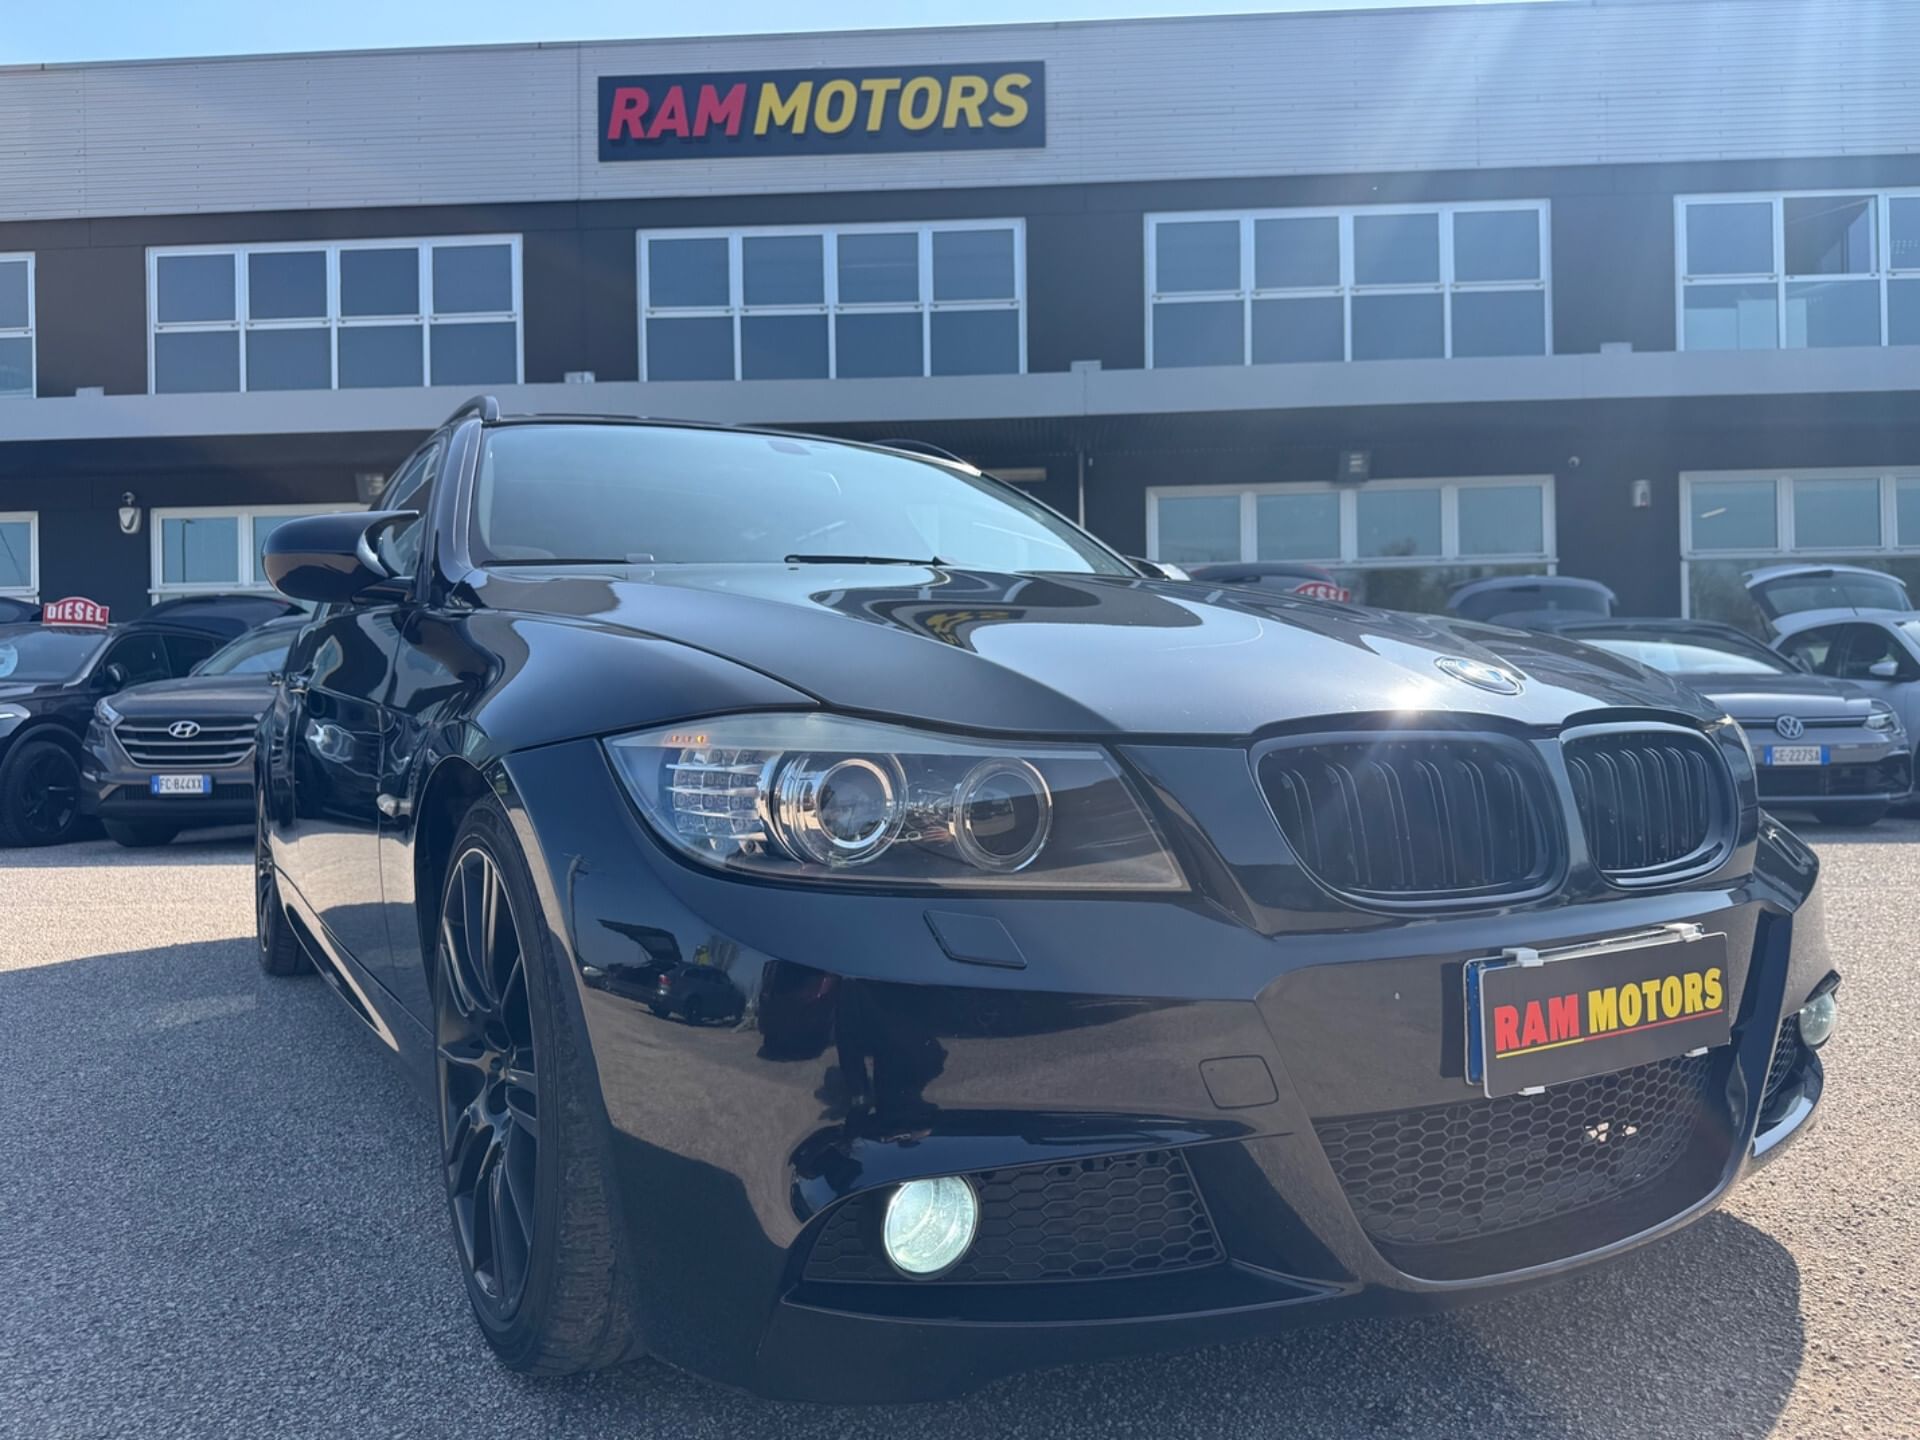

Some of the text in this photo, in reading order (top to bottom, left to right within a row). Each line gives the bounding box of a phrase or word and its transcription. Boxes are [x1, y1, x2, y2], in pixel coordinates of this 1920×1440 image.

[607, 73, 1032, 140] RAM MOTORS
[47, 601, 105, 622] DIESEL
[1494, 967, 1723, 1052] RAM MOTORS
